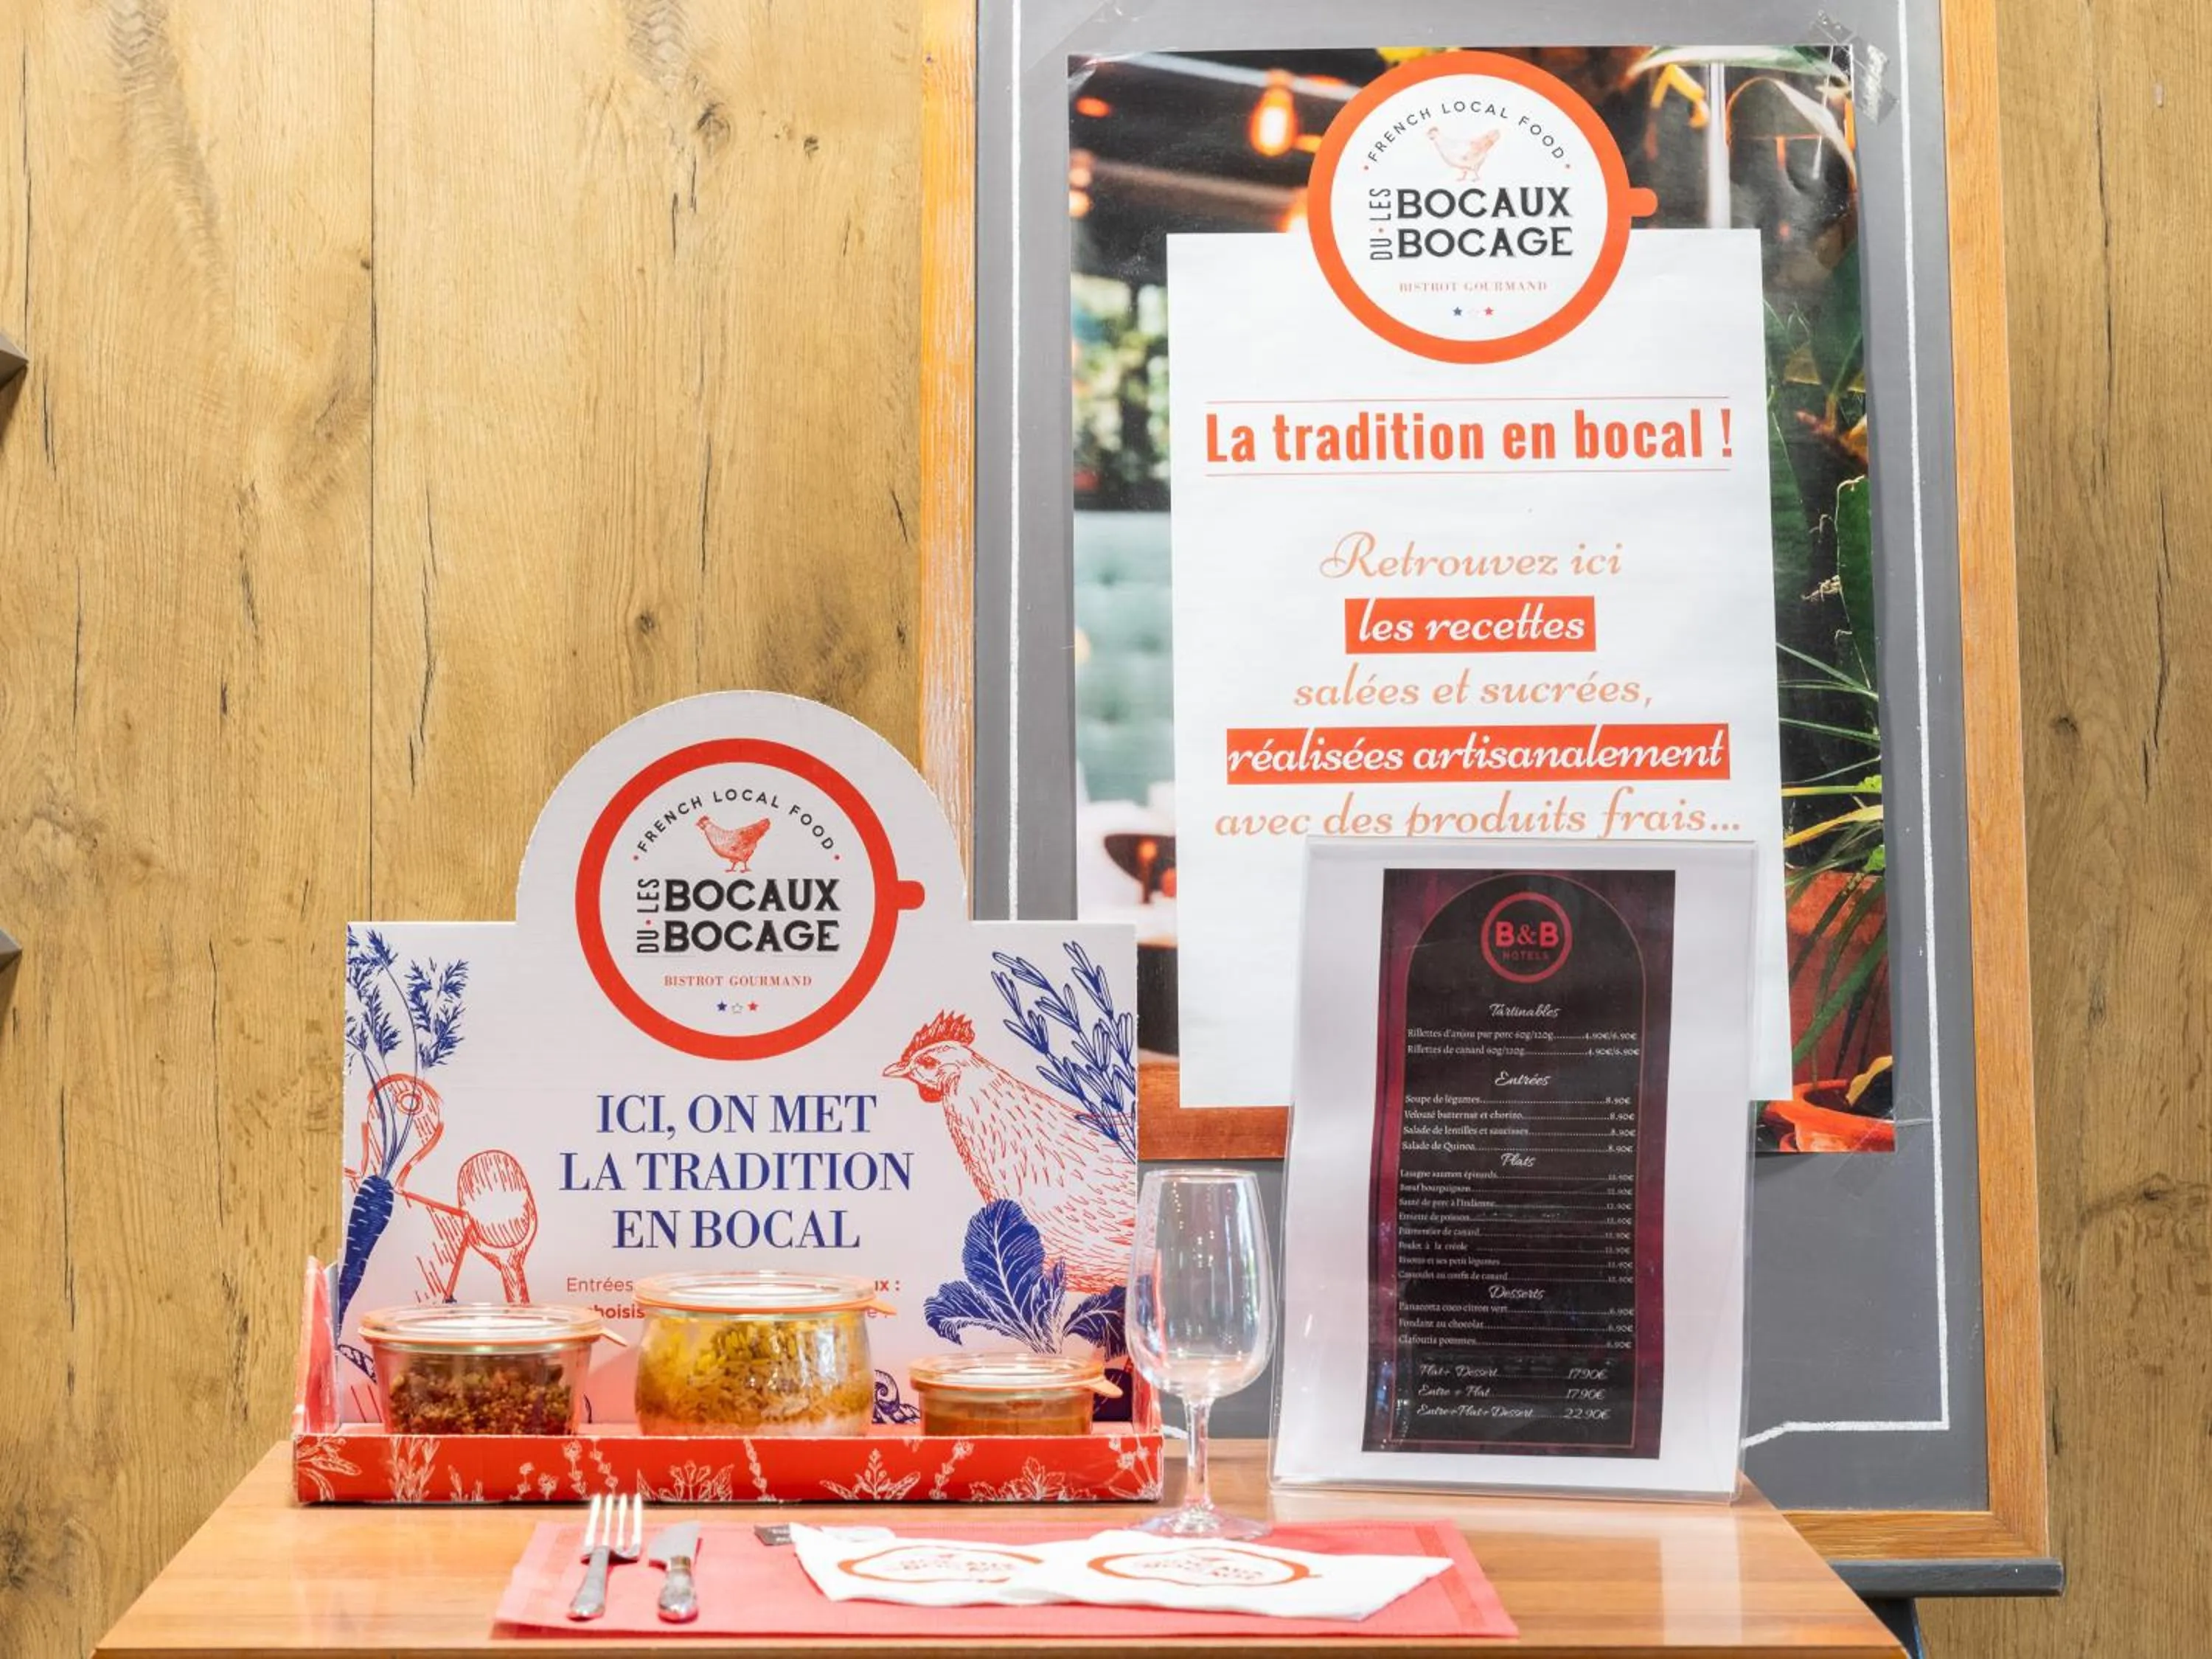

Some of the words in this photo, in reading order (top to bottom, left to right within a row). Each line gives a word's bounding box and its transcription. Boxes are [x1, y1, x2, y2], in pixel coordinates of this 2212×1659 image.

[1368, 107, 1432, 163] FRENCH
[1441, 100, 1509, 119] LOCAL
[1518, 116, 1565, 159] FOOD
[1369, 187, 1391, 220] LES
[1397, 187, 1573, 219] BOCAUX
[1369, 237, 1393, 260] DU
[1397, 226, 1573, 258] BOCAGE
[1399, 282, 1456, 293] BISTROT
[1464, 281, 1548, 292] GOURMAND
[1206, 413, 1255, 462] La
[1273, 411, 1484, 462] tradition
[1502, 421, 1555, 460] en
[1575, 408, 1702, 459] bocal
[1319, 532, 1558, 579] Retrouvez
[1571, 543, 1623, 576] ici
[1358, 599, 1414, 642] les
[1425, 602, 1585, 641] recettes
[1293, 661, 1419, 706] salées
[1433, 668, 1470, 705] et
[1479, 671, 1653, 709] sucrées,
[1229, 728, 1404, 772] réalisées
[1413, 725, 1723, 770] artisanalement
[1215, 813, 1309, 836] avec
[1324, 791, 1393, 835] des
[1405, 790, 1585, 837] produits
[1597, 785, 1741, 838] frais...
[638, 796, 703, 854] FRENCH
[713, 788, 780, 809] LOCAL
[789, 804, 835, 849] FOOD
[637, 877, 659, 914] LES
[664, 878, 841, 912] BOCAUX
[636, 929, 658, 953] DU
[664, 919, 840, 952] BOCAGE
[1495, 922, 1559, 947] B&B
[1502, 951, 1548, 961] HOTELS
[664, 975, 724, 987] BISTROT
[729, 975, 812, 987] GOURMAND
[1489, 1004, 1561, 1018] Tartinables
[1408, 1028, 1441, 1037] Rillettes
[1408, 1044, 1441, 1054] Rillettes
[1443, 1044, 1454, 1054] de
[1455, 1044, 1484, 1054] canard
[1495, 1071, 1551, 1086] Entrées
[1405, 1096, 1431, 1105] Soupe
[1433, 1094, 1444, 1104] de
[1444, 1094, 1481, 1105] légumes
[596, 1095, 676, 1140] ICI,
[688, 1094, 759, 1134] ON
[769, 1094, 877, 1134] MET
[1404, 1110, 1436, 1119] Velouté
[1438, 1110, 1478, 1119] butternut
[1480, 1111, 1488, 1119] et
[1403, 1126, 1430, 1135] Salade
[1432, 1126, 1443, 1135] de
[1444, 1126, 1477, 1135] lentilles
[1402, 1141, 1430, 1150] Salade
[1431, 1141, 1441, 1150] de
[1443, 1142, 1475, 1152] Quinoa
[1500, 1152, 1536, 1167] Plats
[559, 1152, 625, 1192] LA
[636, 1151, 915, 1192] TRADITION
[1421, 1198, 1430, 1206] de
[612, 1210, 681, 1249] EN
[691, 1209, 861, 1250] BOCAL
[1442, 1227, 1452, 1235] de
[1425, 1242, 1430, 1250] à
[1434, 1242, 1442, 1250] la
[567, 1276, 633, 1293] Entrées
[1488, 1285, 1546, 1299] Desserts
[588, 1304, 646, 1319] hoisis
[1463, 1304, 1489, 1312] citron
[1399, 1318, 1434, 1328] Fondant
[1447, 1319, 1484, 1329] chocolat
[1455, 1365, 1498, 1377] Dessert
[1465, 1385, 1490, 1397] Plat
